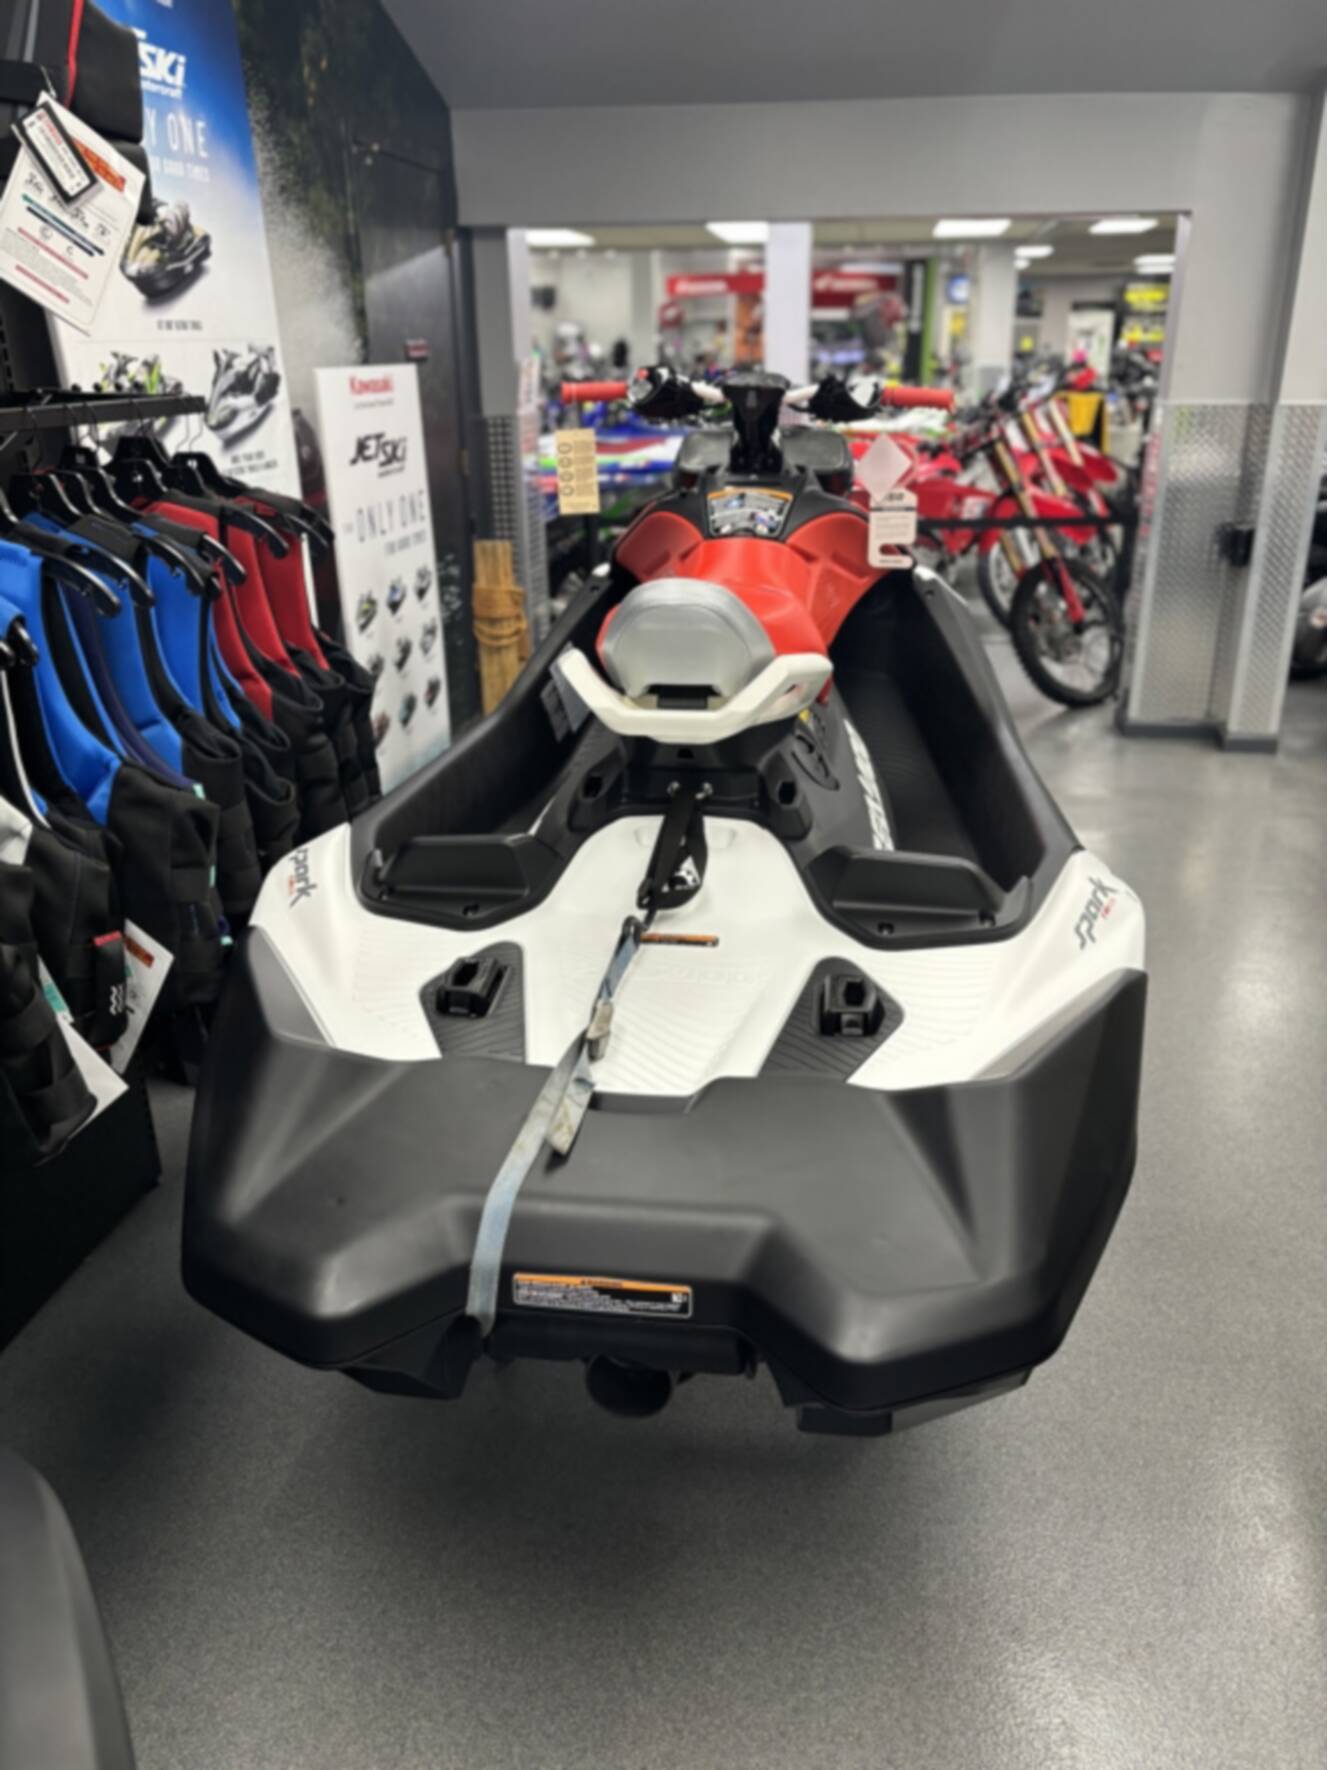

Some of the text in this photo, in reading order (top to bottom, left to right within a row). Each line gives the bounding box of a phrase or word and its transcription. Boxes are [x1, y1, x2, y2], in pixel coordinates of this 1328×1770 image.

[166, 111, 208, 158] ONE
[350, 432, 385, 466] JET
[1074, 876, 1118, 950] spark
